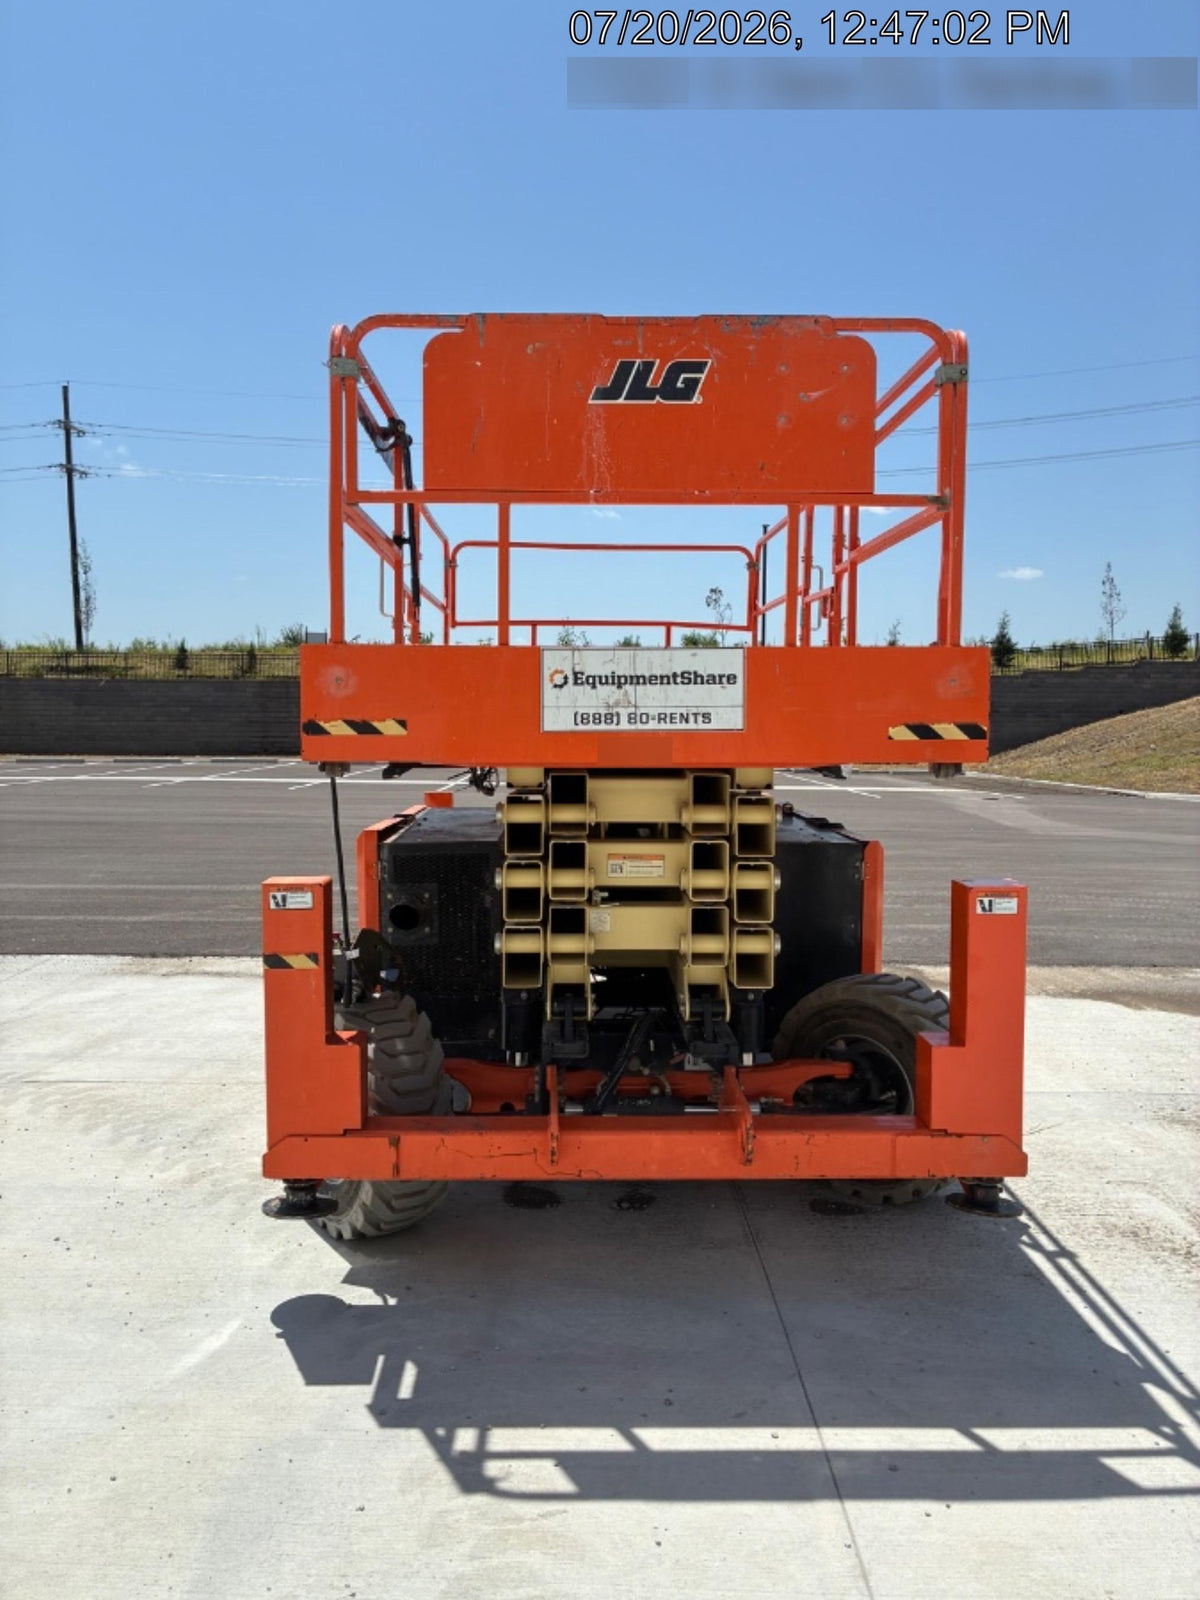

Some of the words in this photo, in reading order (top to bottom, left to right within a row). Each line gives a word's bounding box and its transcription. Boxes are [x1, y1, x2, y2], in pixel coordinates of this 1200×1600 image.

[588, 358, 711, 404] JLG
[572, 671, 737, 689] EquipmentShare
[573, 711, 621, 726] (888)
[627, 711, 713, 725] 80-RENTS
